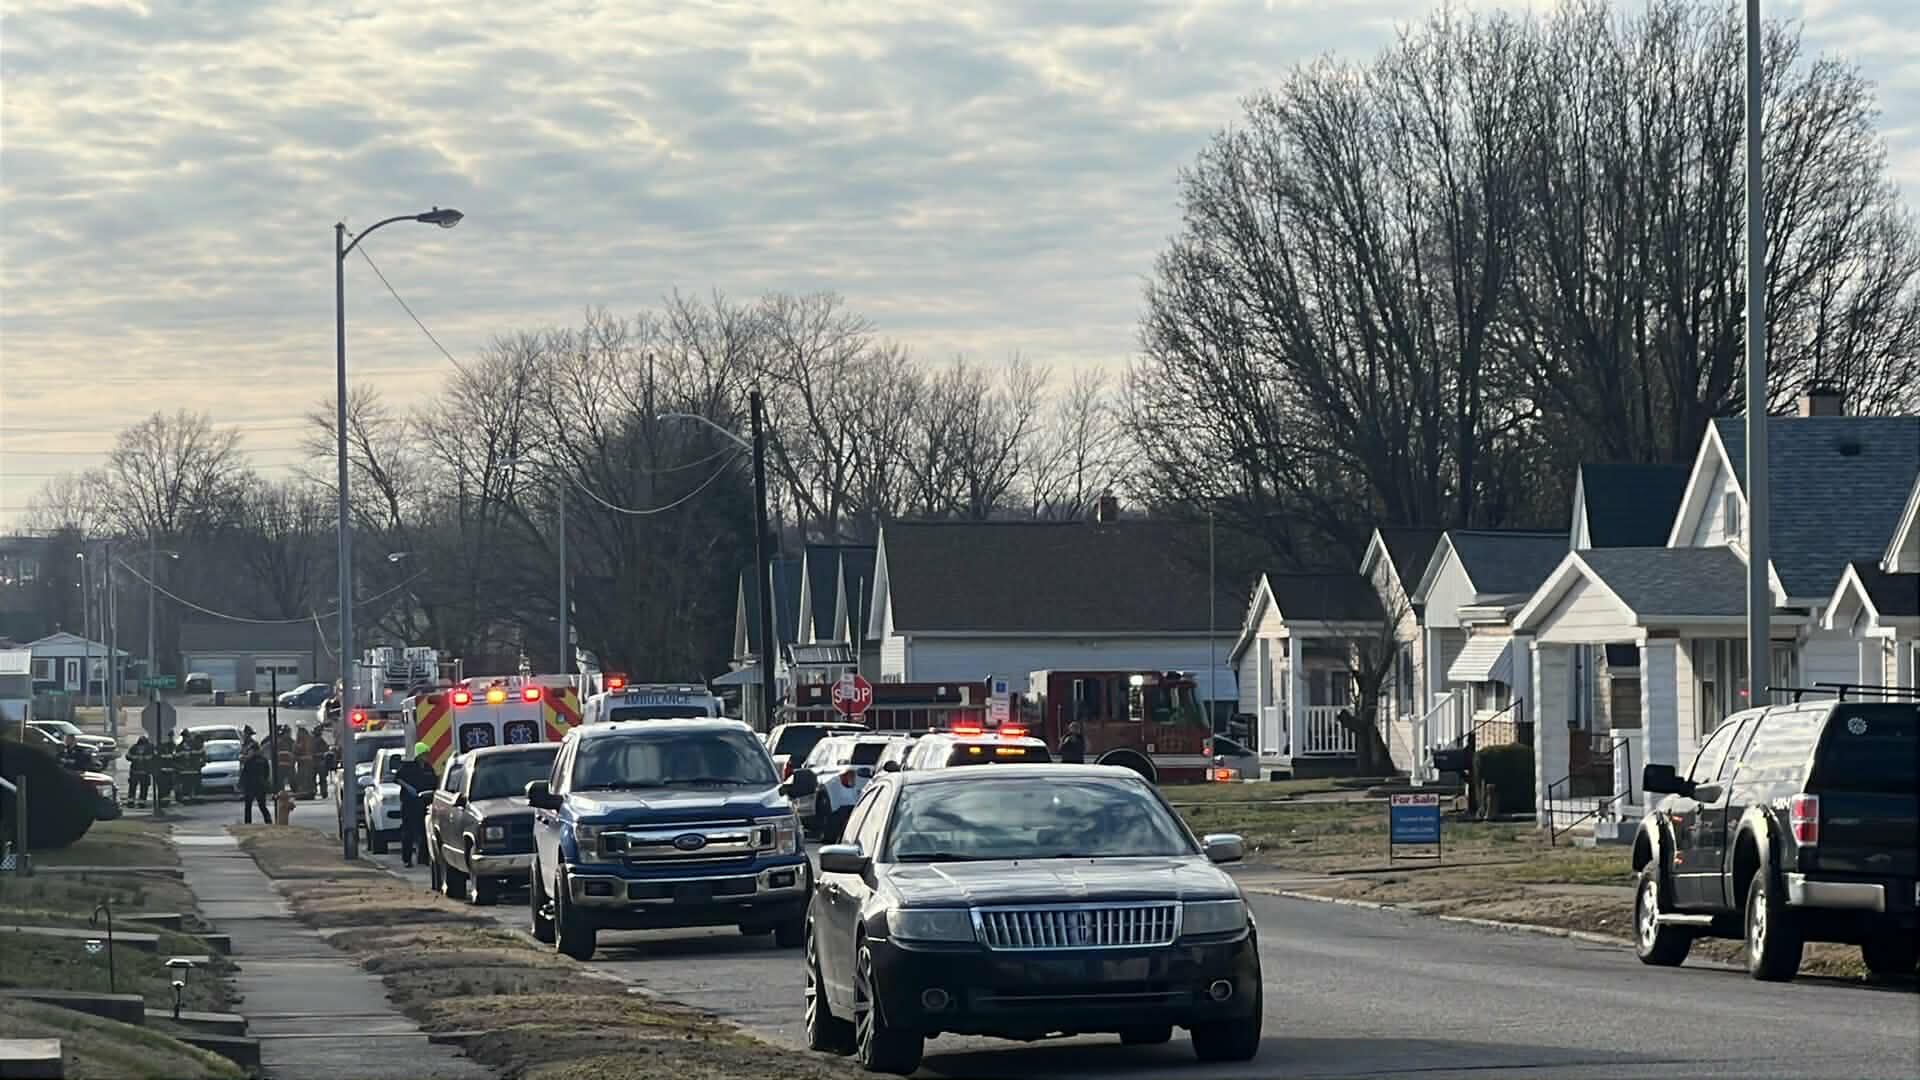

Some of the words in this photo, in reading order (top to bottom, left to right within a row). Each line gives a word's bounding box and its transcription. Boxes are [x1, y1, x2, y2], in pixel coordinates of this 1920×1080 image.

[624, 695, 691, 705] AMBULANCE
[834, 687, 870, 703] SOP
[1392, 794, 1410, 804] For
[1412, 793, 1437, 804] Sale
